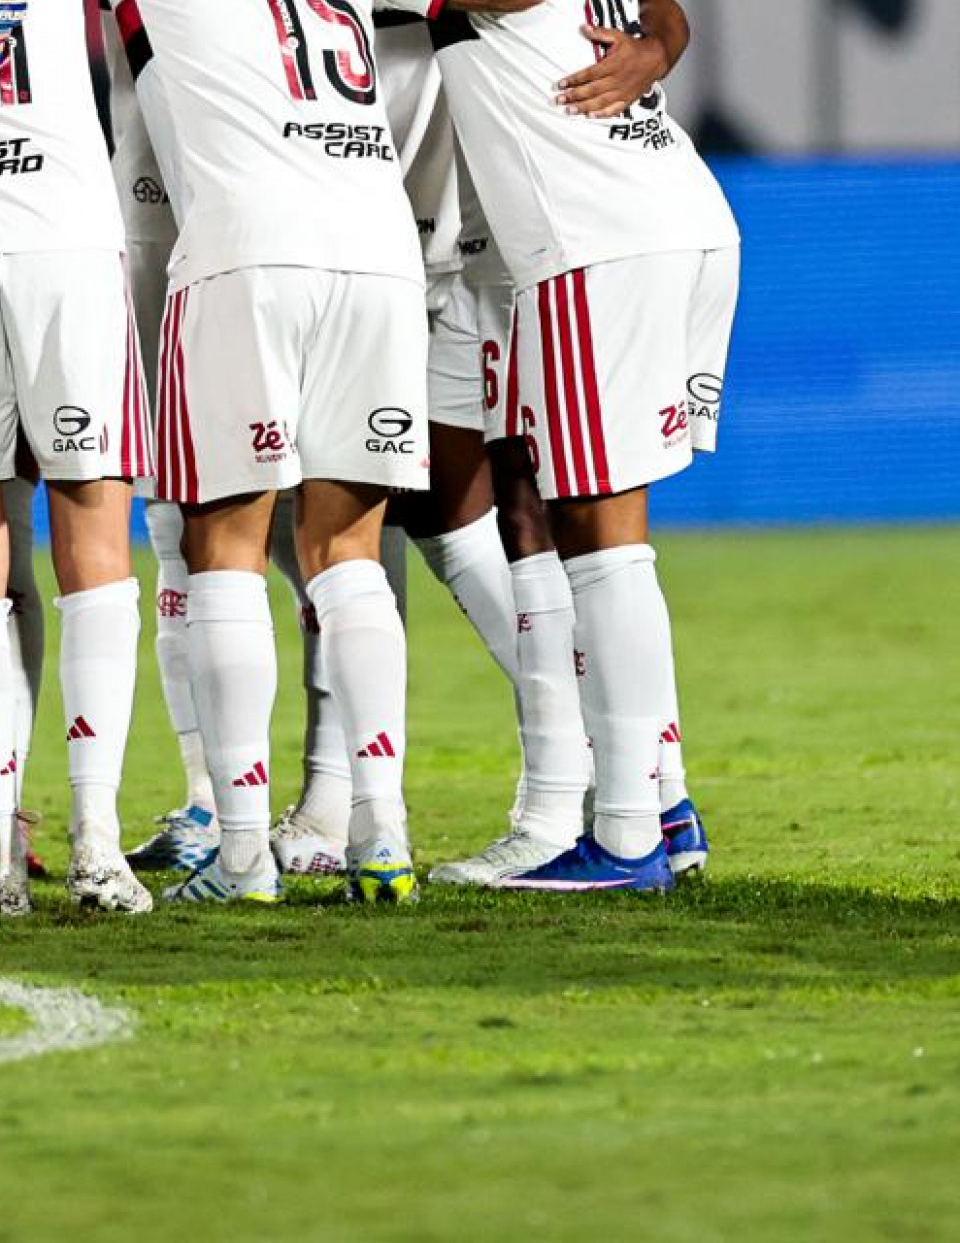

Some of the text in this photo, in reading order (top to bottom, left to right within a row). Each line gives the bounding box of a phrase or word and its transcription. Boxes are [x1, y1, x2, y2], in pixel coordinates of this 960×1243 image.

[283, 122, 386, 143] ASSIST
[52, 437, 96, 452] GAC
[248, 420, 285, 453] Zé
[365, 439, 415, 454] GAC
